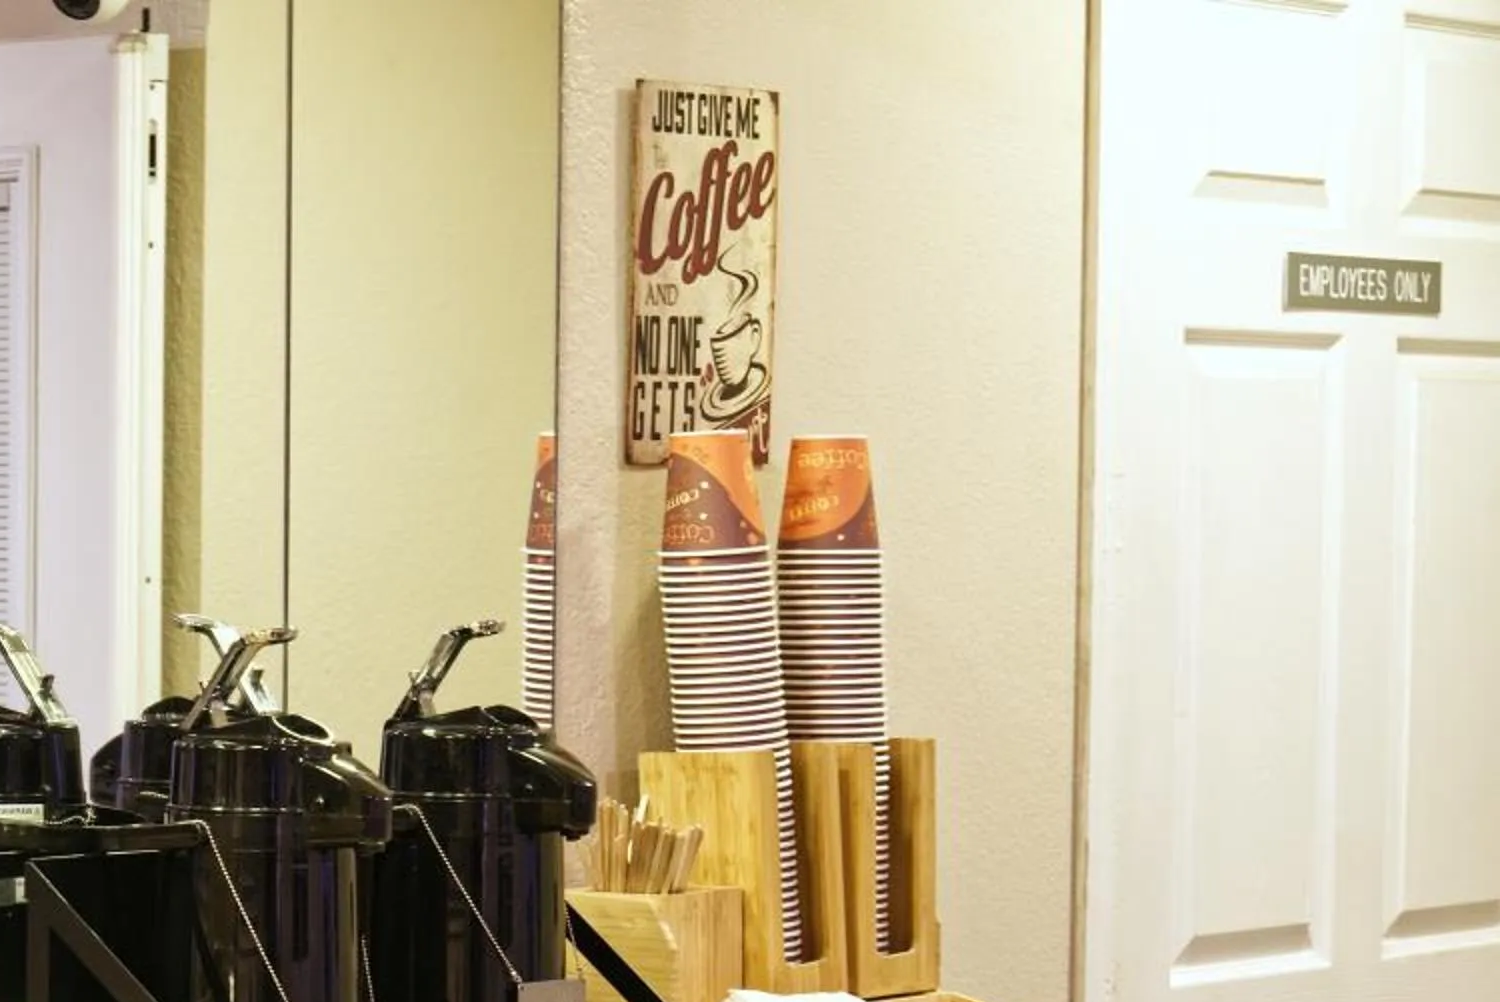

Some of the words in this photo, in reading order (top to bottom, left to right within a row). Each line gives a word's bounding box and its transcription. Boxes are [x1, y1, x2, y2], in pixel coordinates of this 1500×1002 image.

[652, 89, 694, 134] JUST
[697, 93, 733, 137] GIVE
[735, 96, 760, 140] ME
[637, 139, 775, 284] Coffee
[644, 283, 679, 306] AND
[1300, 264, 1387, 300] EMPLOYEES
[1394, 270, 1432, 303] ONLY
[634, 315, 661, 375] NO
[666, 315, 703, 376] ONE
[632, 381, 696, 440] GETS
